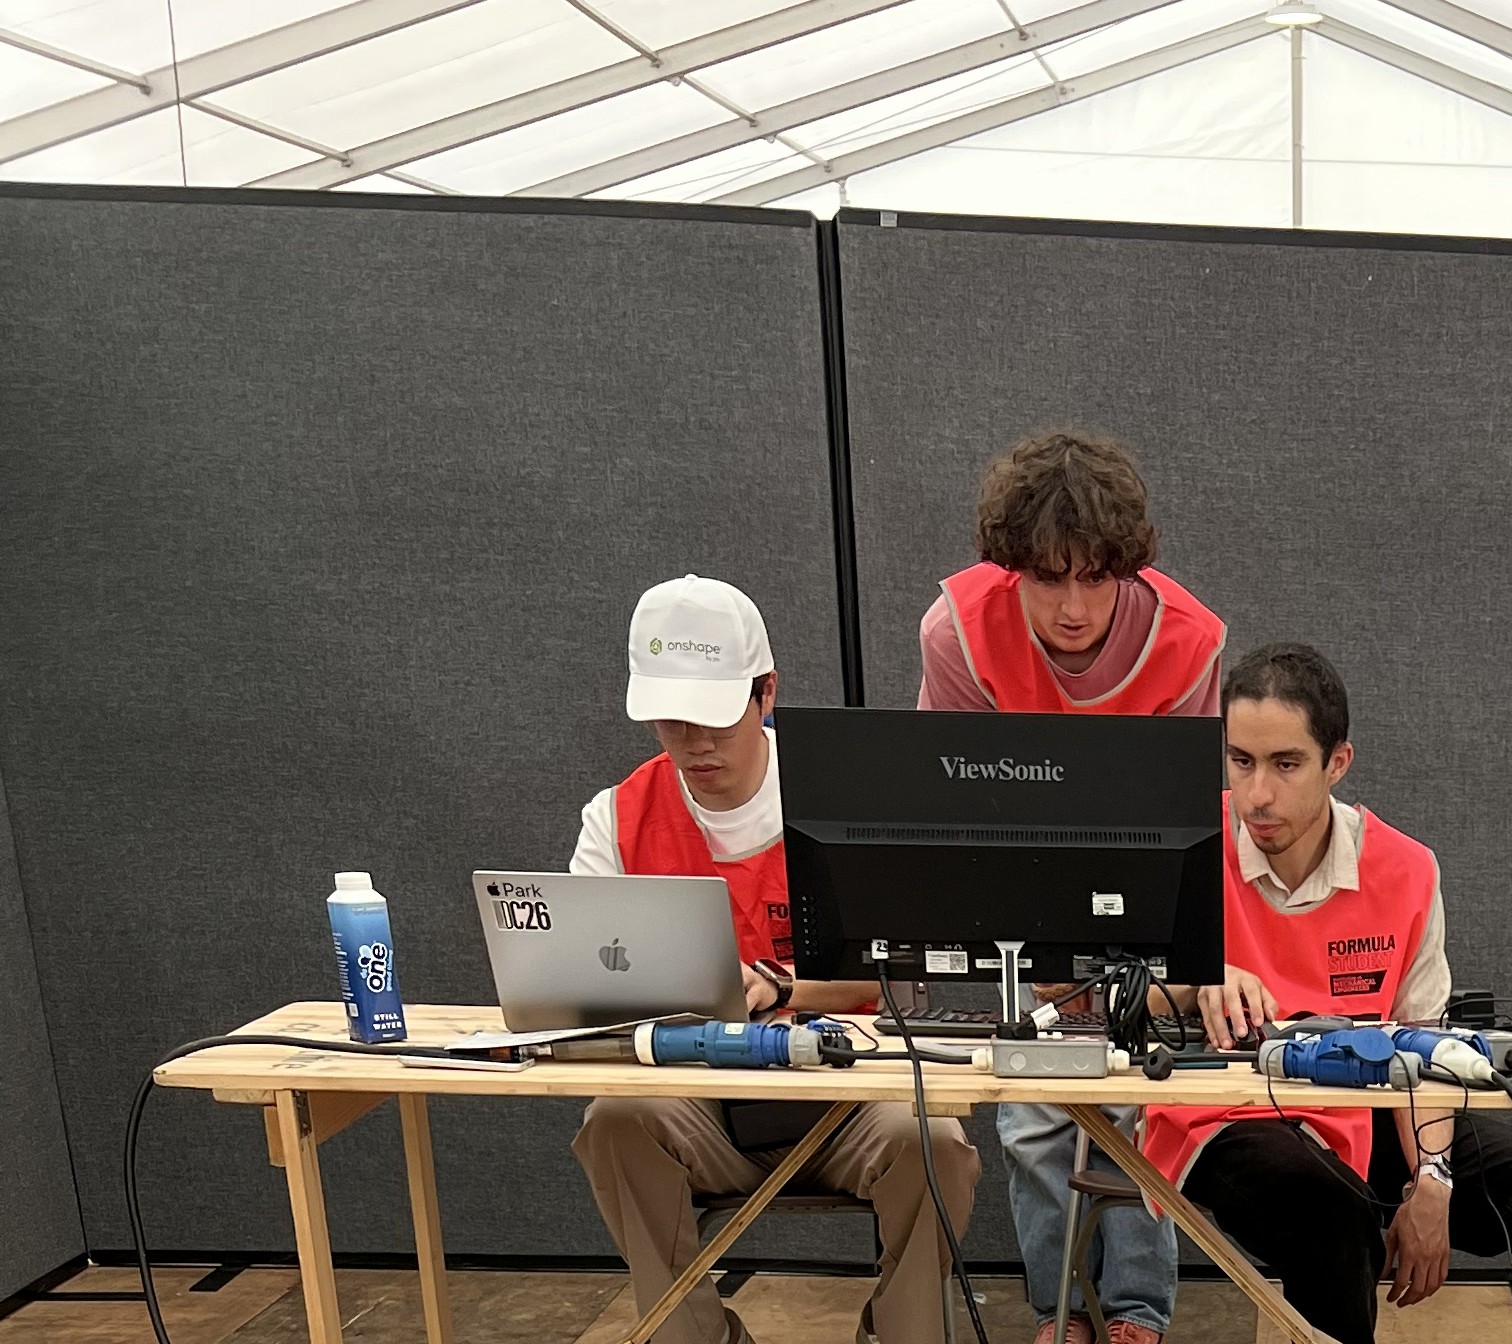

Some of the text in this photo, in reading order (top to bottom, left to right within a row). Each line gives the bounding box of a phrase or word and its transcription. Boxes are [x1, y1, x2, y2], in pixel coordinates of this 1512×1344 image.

[667, 640, 720, 655] onshape
[940, 756, 1065, 782] ViewSonic
[502, 882, 544, 898] Park
[1328, 935, 1395, 956] FORMULA
[368, 943, 387, 992] one
[1327, 951, 1394, 973] STUDENT
[373, 1022, 402, 1030] WATER
[374, 1013, 399, 1021] STILL
